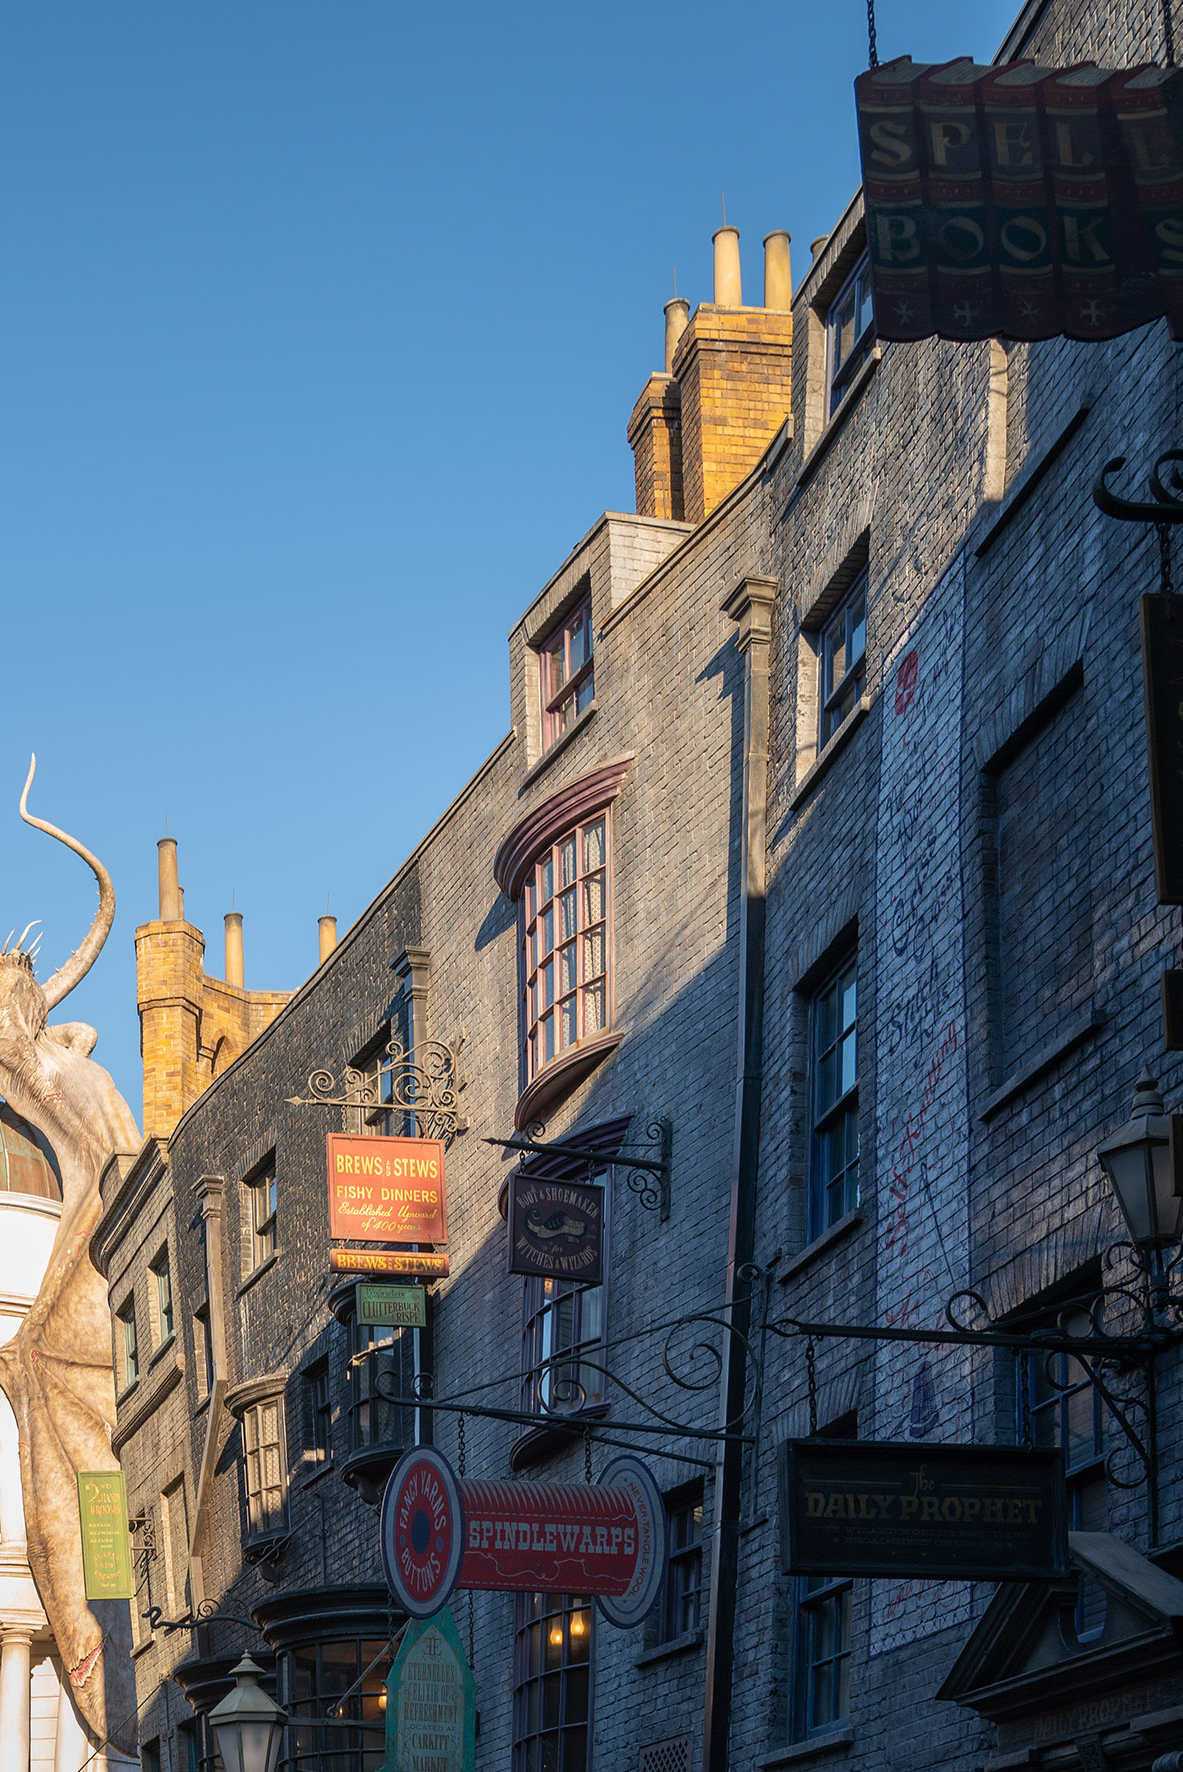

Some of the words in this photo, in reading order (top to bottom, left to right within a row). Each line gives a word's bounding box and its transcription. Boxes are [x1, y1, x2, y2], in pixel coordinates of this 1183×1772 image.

[869, 119, 1173, 171] SPELL
[336, 1154, 383, 1175] BREWS
[394, 1158, 438, 1178] STEWS
[336, 1185, 373, 1199] FISHY
[381, 1187, 438, 1203] DINNERS
[515, 1185, 538, 1209] BOOT
[545, 1187, 600, 1219] SHOEMAKER
[338, 1201, 393, 1217] Established
[398, 1205, 437, 1223] Upward
[362, 1217, 376, 1232] of
[373, 1221, 396, 1231] 400
[337, 1254, 387, 1270] BREWS
[394, 1257, 443, 1271] STEWS
[516, 1236, 554, 1270] WITCHES
[560, 1245, 598, 1271] WIZARDS
[362, 1301, 420, 1319] CLUTTERBUCK
[399, 1473, 419, 1529] FANCY
[420, 1470, 447, 1531] YARNS
[805, 1492, 897, 1519] DAILY
[897, 1495, 1042, 1524] PROPHET
[469, 1520, 635, 1555] SPINDLEWARPS
[400, 1546, 441, 1593] BUTTONS
[628, 1567, 647, 1597] WOOL
[413, 1683, 438, 1701] ELIXIR
[441, 1684, 449, 1702] OF
[404, 1703, 458, 1723] REFRESHMENT
[405, 1723, 444, 1732] LOCATED
[411, 1734, 450, 1751] CARKITT
[412, 1756, 449, 1772] MARKET
